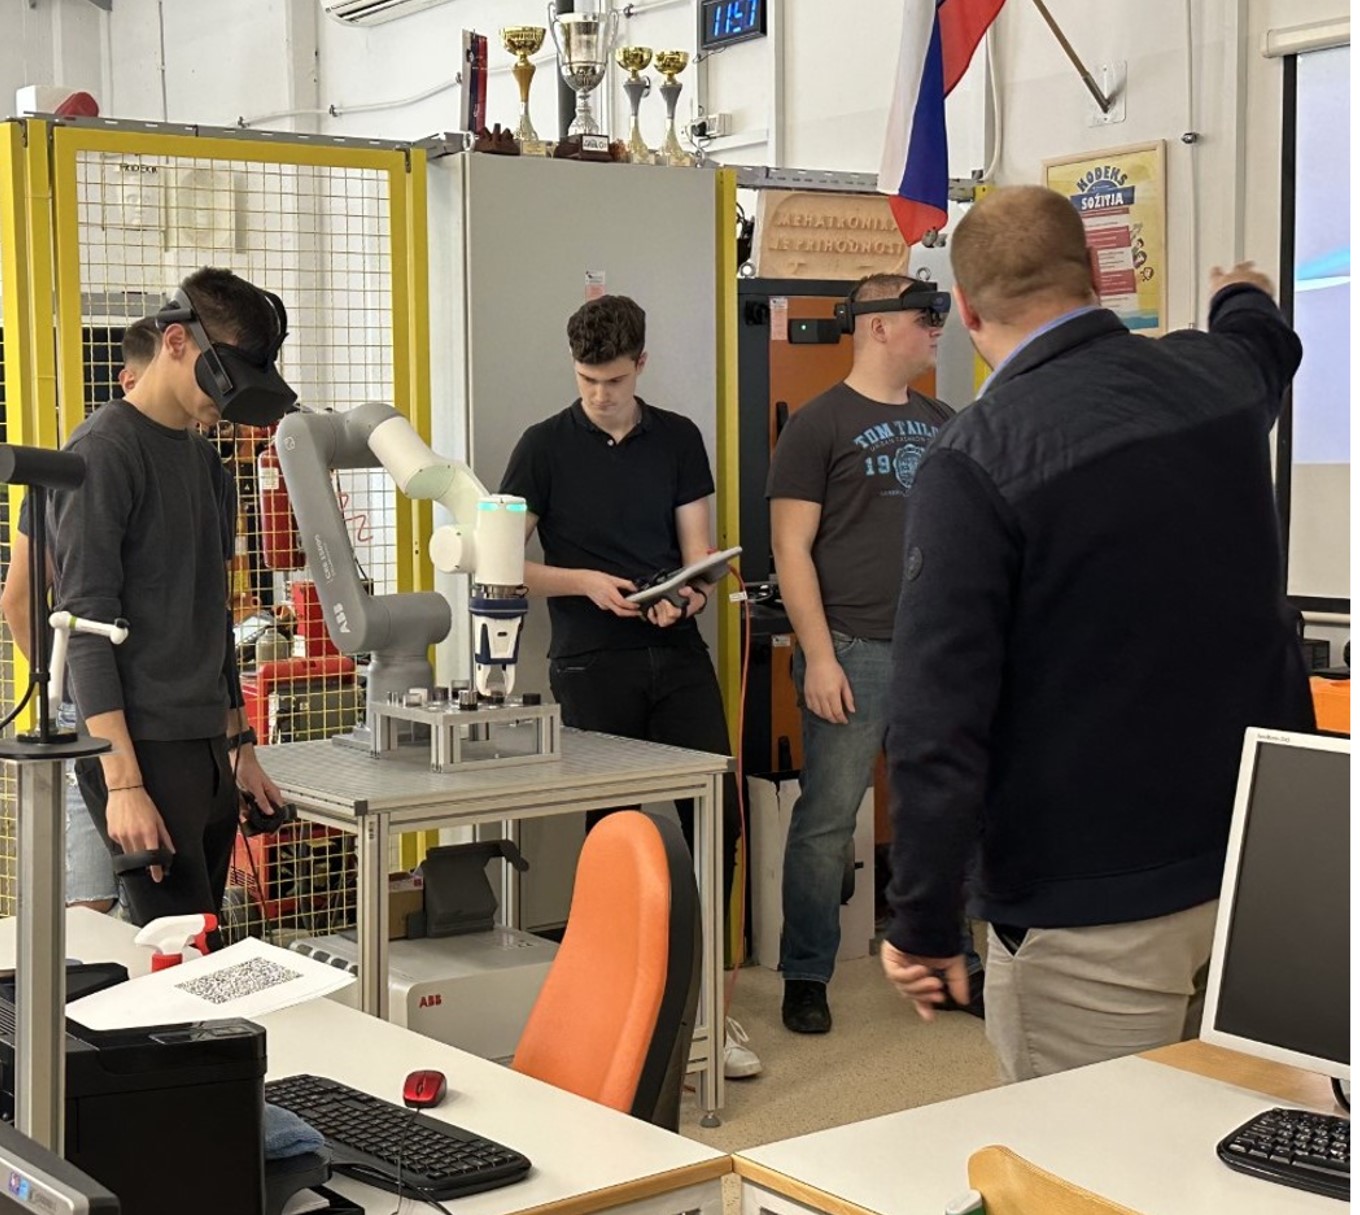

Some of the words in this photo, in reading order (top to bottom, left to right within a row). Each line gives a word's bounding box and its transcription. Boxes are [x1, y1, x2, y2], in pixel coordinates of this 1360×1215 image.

[1076, 165, 1128, 192] KODEKS
[1081, 192, 1124, 210] SOŽITJA
[853, 422, 895, 449] TOM
[333, 602, 351, 633] ABB
[419, 994, 442, 1009] ABB
